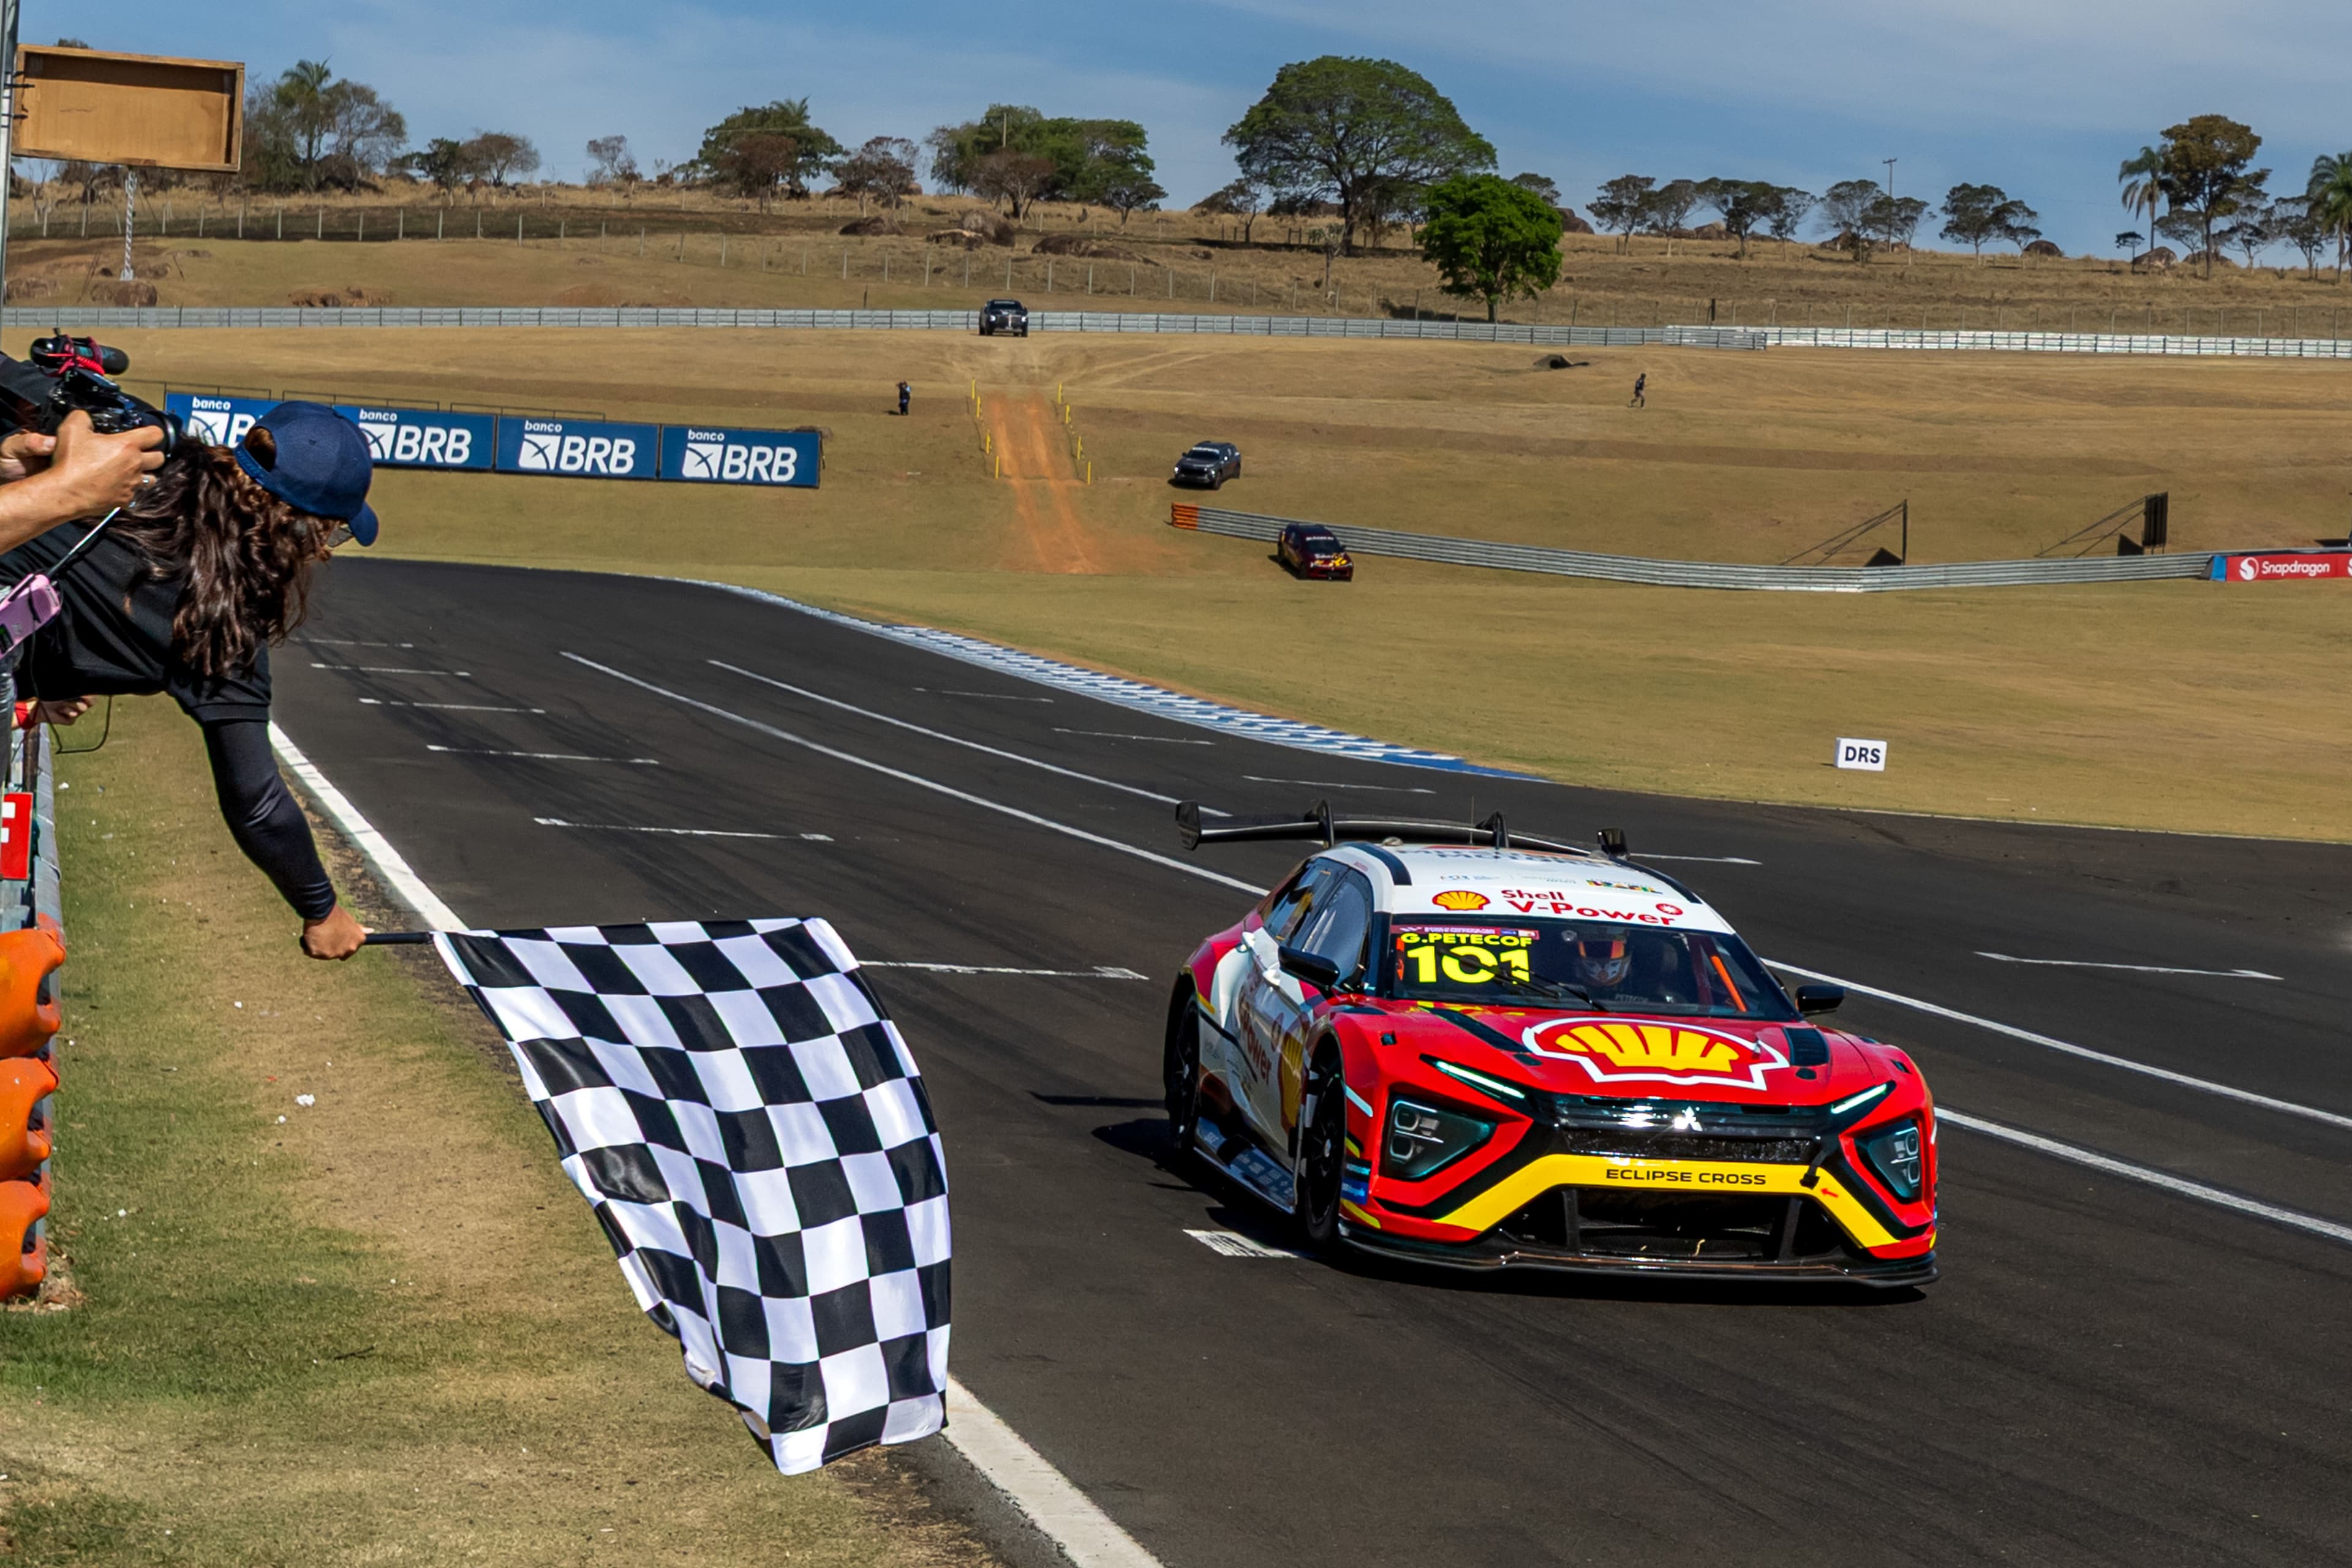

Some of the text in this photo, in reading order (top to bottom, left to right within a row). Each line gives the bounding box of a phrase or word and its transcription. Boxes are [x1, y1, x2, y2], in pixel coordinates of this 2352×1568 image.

[192, 396, 232, 411] banco
[359, 409, 398, 423] banco
[524, 420, 562, 433] banco
[688, 429, 725, 442] banco
[394, 426, 472, 464] BRB
[559, 435, 636, 474] BRB
[722, 444, 797, 482] BRB
[2261, 560, 2331, 576] Snapdragon
[1845, 746, 1880, 763] DRS
[1501, 889, 1565, 900] Shell
[1506, 900, 1676, 925] V-Power
[1400, 933, 1532, 947] G.PETECOF
[1407, 946, 1530, 984] 101
[1606, 1169, 1766, 1185] ECLIPSE CROSS
